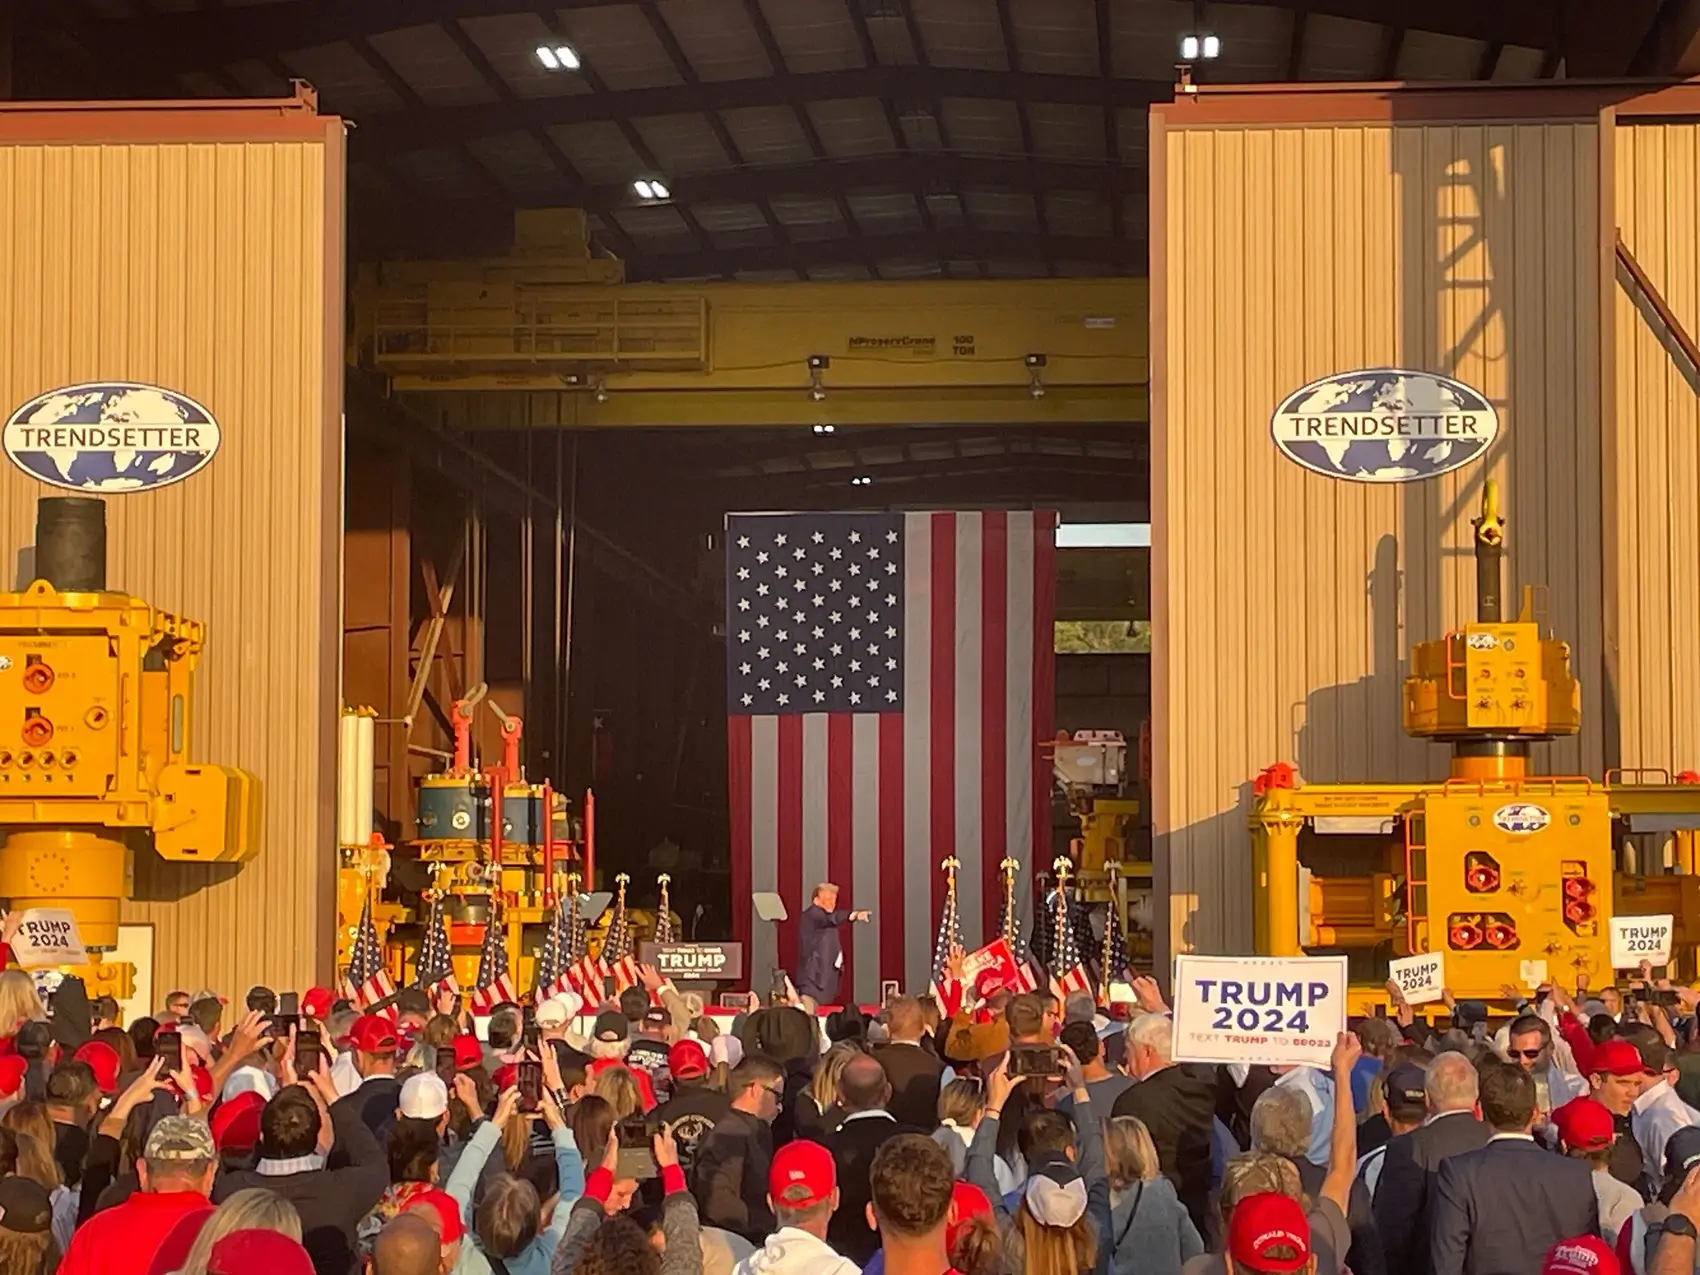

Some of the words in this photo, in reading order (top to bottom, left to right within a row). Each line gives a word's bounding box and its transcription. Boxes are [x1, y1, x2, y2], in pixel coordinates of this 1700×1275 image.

[953, 336, 974, 344] 100
[952, 346, 976, 356] TON
[1289, 415, 1478, 437] TRENDSETTER
[20, 427, 200, 448] TRENDSETTER
[18, 920, 71, 936] TRUMP
[1619, 927, 1668, 940] TRUMP
[29, 934, 69, 948] 2024
[1627, 940, 1661, 952] 2024
[657, 953, 726, 968] TRUMP
[1395, 962, 1438, 981] TRUMP
[1402, 975, 1433, 991] 2024
[1195, 980, 1329, 1007] TRUMP
[1212, 1007, 1309, 1033] 2024
[1189, 1032, 1220, 1044] TEXT
[1224, 1034, 1269, 1045] TRUMP
[1273, 1036, 1290, 1047] TO
